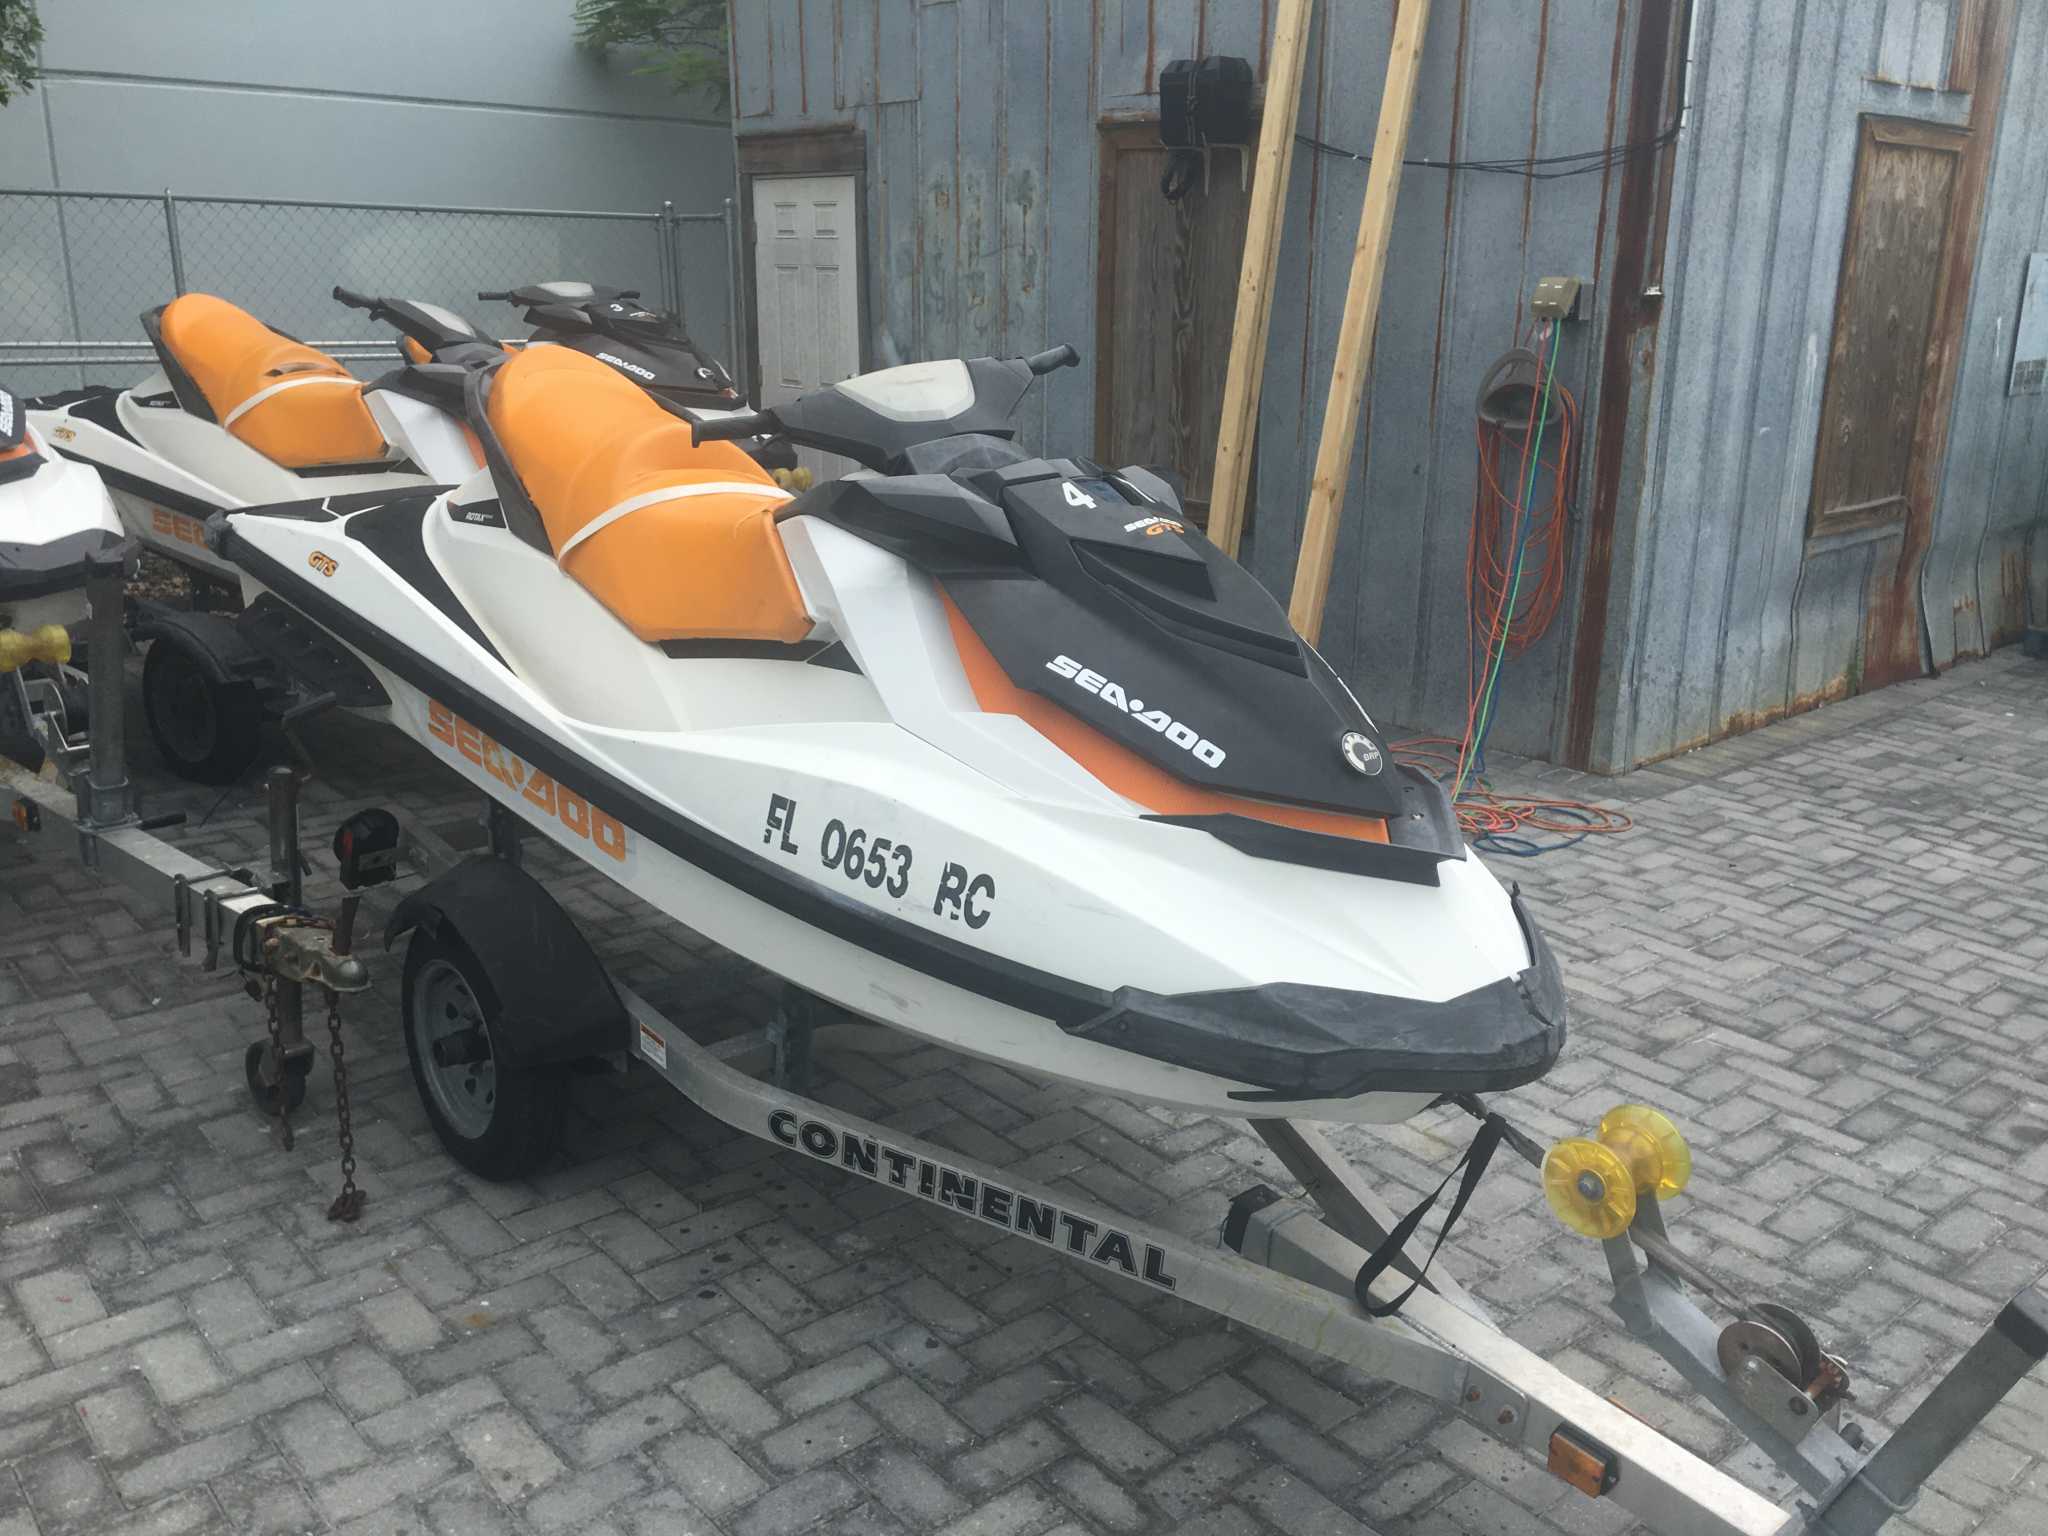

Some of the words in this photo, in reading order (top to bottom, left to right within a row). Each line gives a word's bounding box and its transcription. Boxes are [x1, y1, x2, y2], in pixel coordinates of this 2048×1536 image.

[610, 303, 624, 313] 3
[1062, 482, 1097, 510] 4
[308, 551, 338, 577] GTS
[763, 792, 799, 855] FL
[820, 818, 913, 899] 0653
[933, 860, 996, 930] RC
[767, 1109, 1177, 1291] CONTINENTAL
